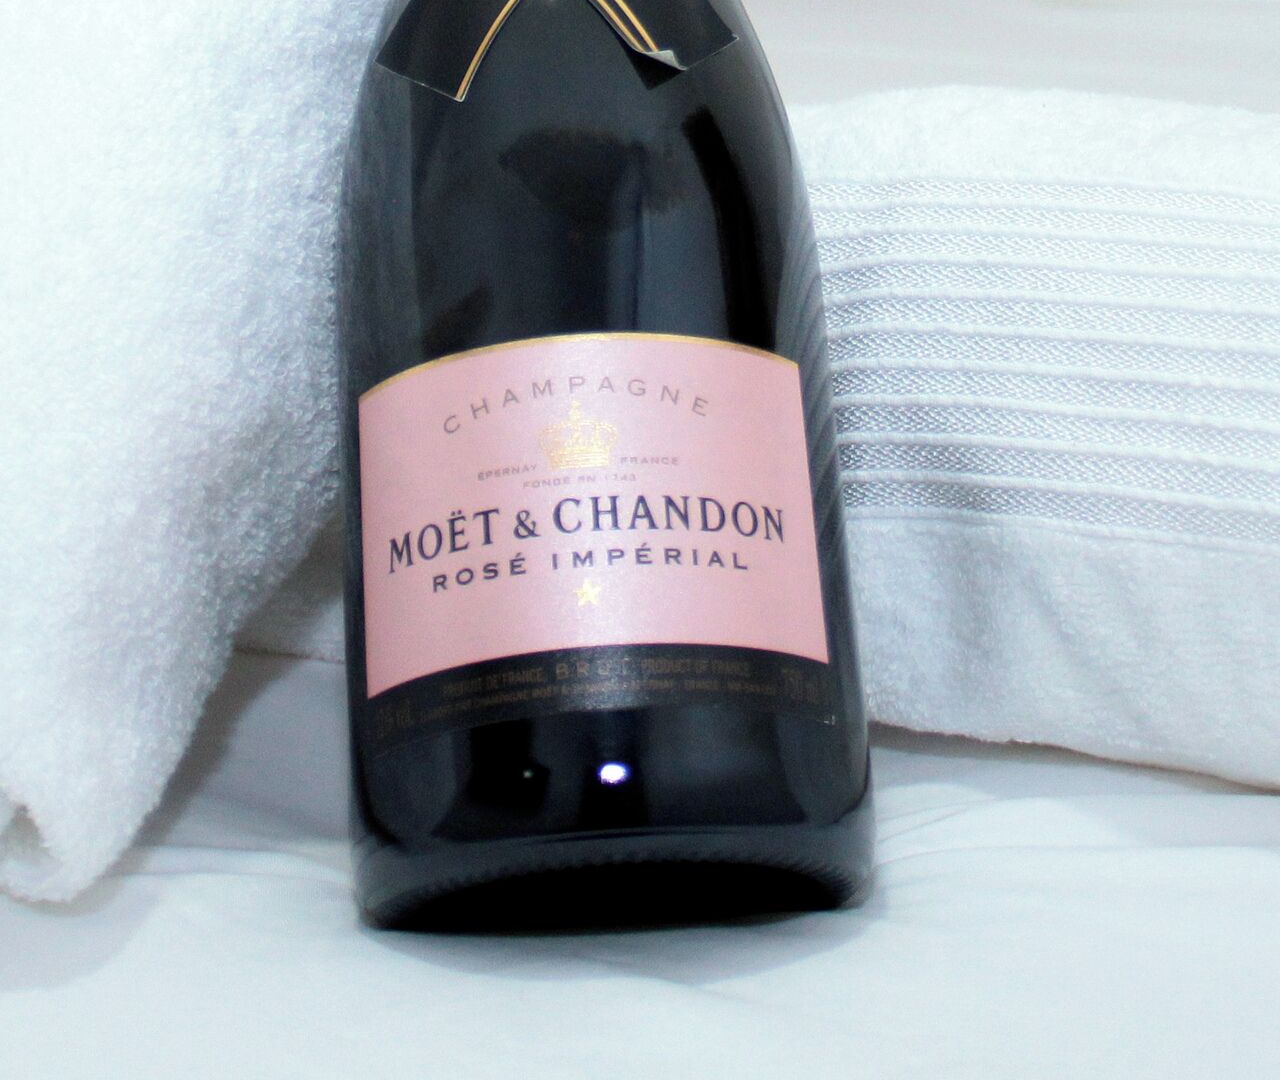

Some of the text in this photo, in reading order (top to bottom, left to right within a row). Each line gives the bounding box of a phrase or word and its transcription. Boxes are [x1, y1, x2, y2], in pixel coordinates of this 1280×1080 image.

[442, 376, 709, 435] CHAMPAGNE
[620, 456, 679, 466] FRANCE
[388, 494, 786, 575] MOËT & CHANDON
[432, 542, 749, 593] ROSÉ IMPÉRIAL
